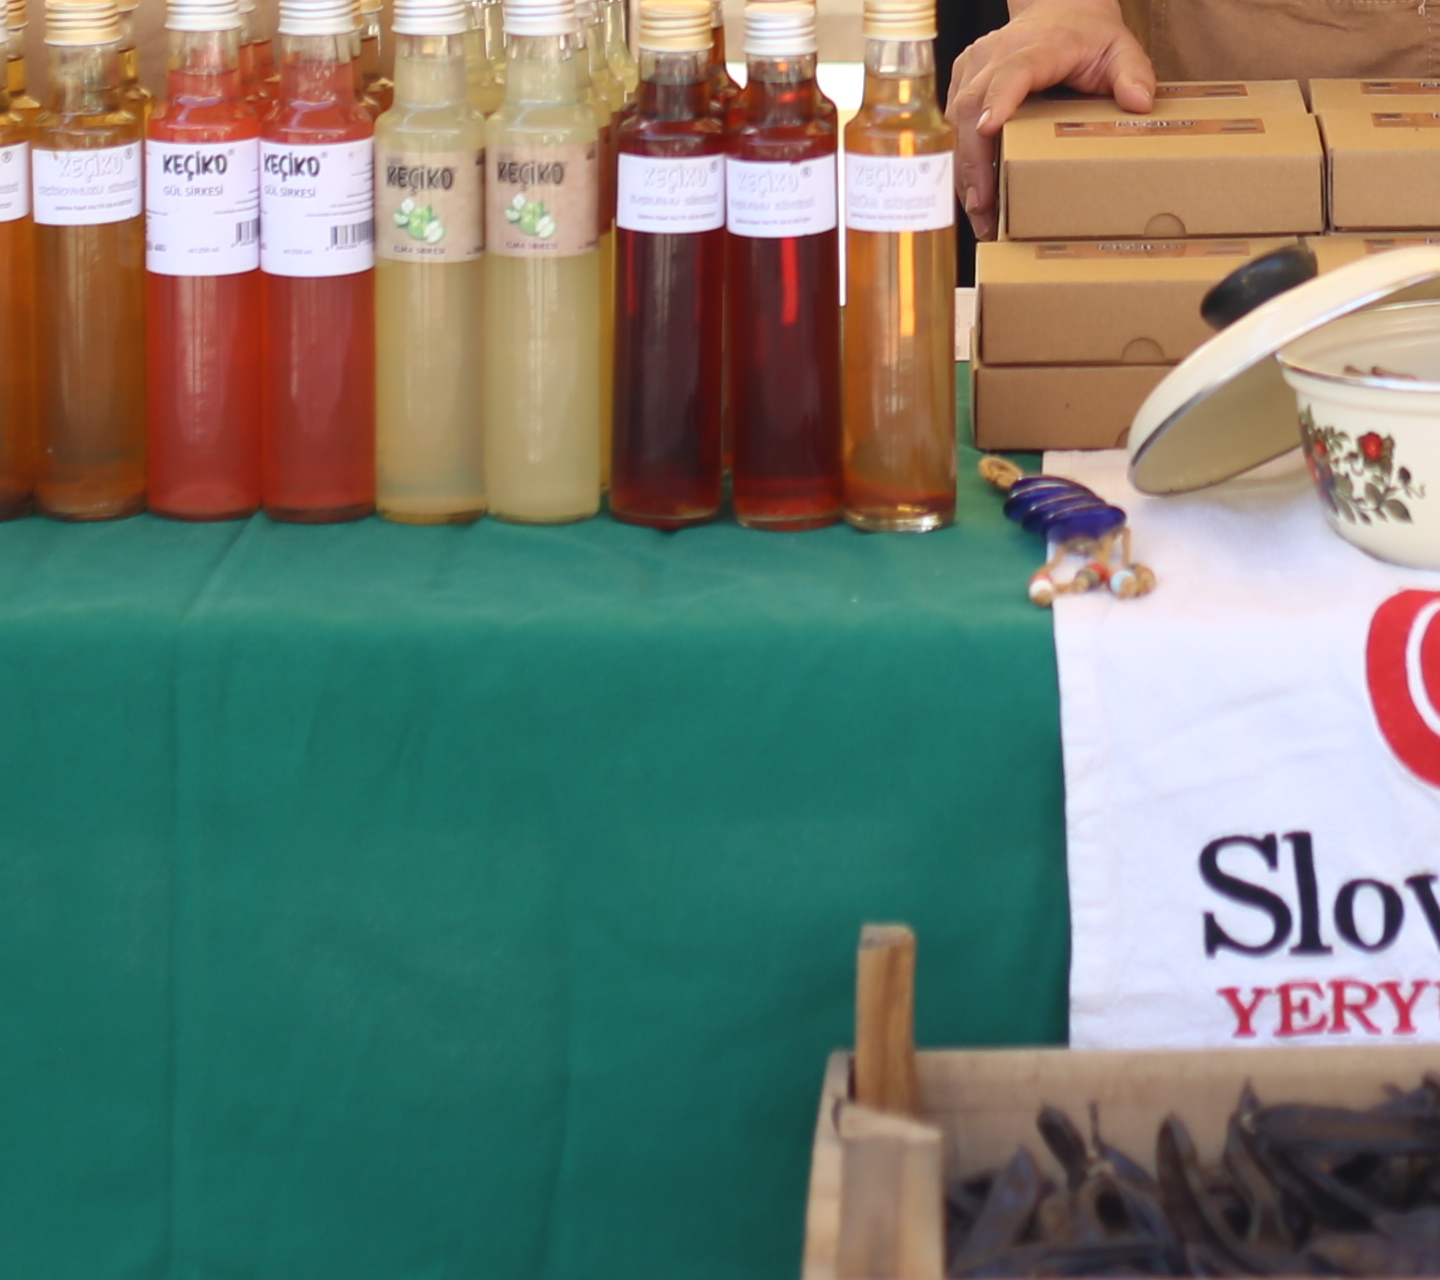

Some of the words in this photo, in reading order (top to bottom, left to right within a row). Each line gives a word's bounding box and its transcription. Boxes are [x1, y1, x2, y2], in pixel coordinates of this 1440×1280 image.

[162, 150, 228, 182] KEÇİKO
[264, 151, 320, 182] KEÇİKO
[387, 163, 453, 195] KEÇİKO
[497, 159, 564, 191] KEÇİKO
[163, 184, 182, 197] GÜL
[185, 184, 224, 197] SİRKESİ
